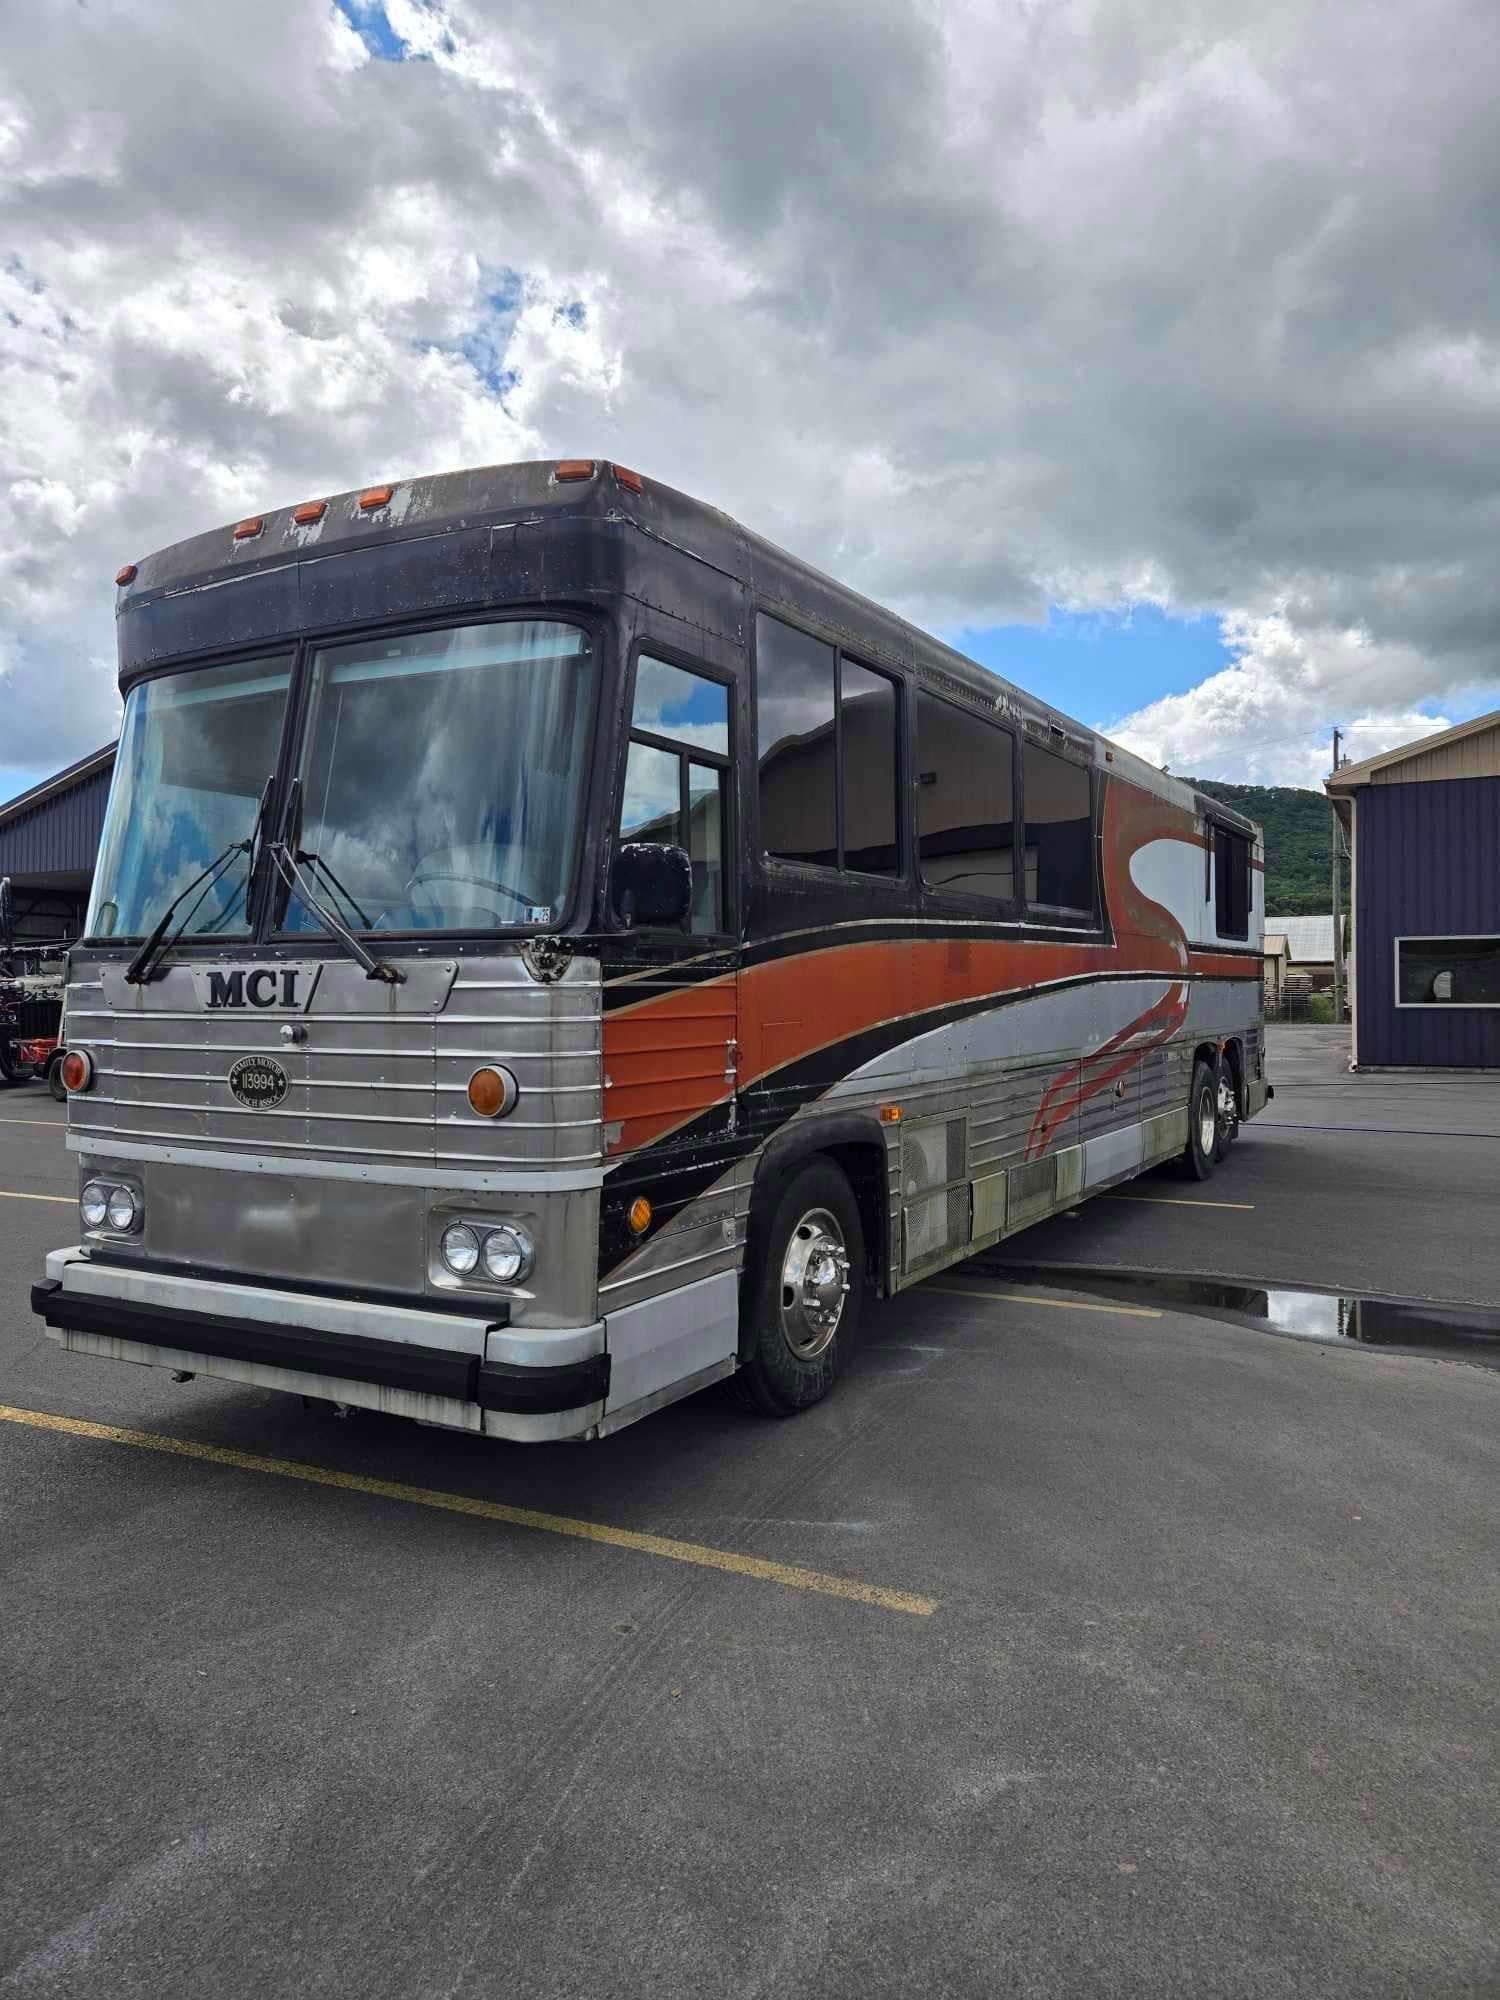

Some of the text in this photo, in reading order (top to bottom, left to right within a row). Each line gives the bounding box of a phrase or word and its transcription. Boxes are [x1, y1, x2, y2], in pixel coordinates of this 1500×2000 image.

[206, 969, 300, 1008] MCI
[257, 1058, 282, 1076] MOTOR
[242, 1073, 274, 1090] 113994
